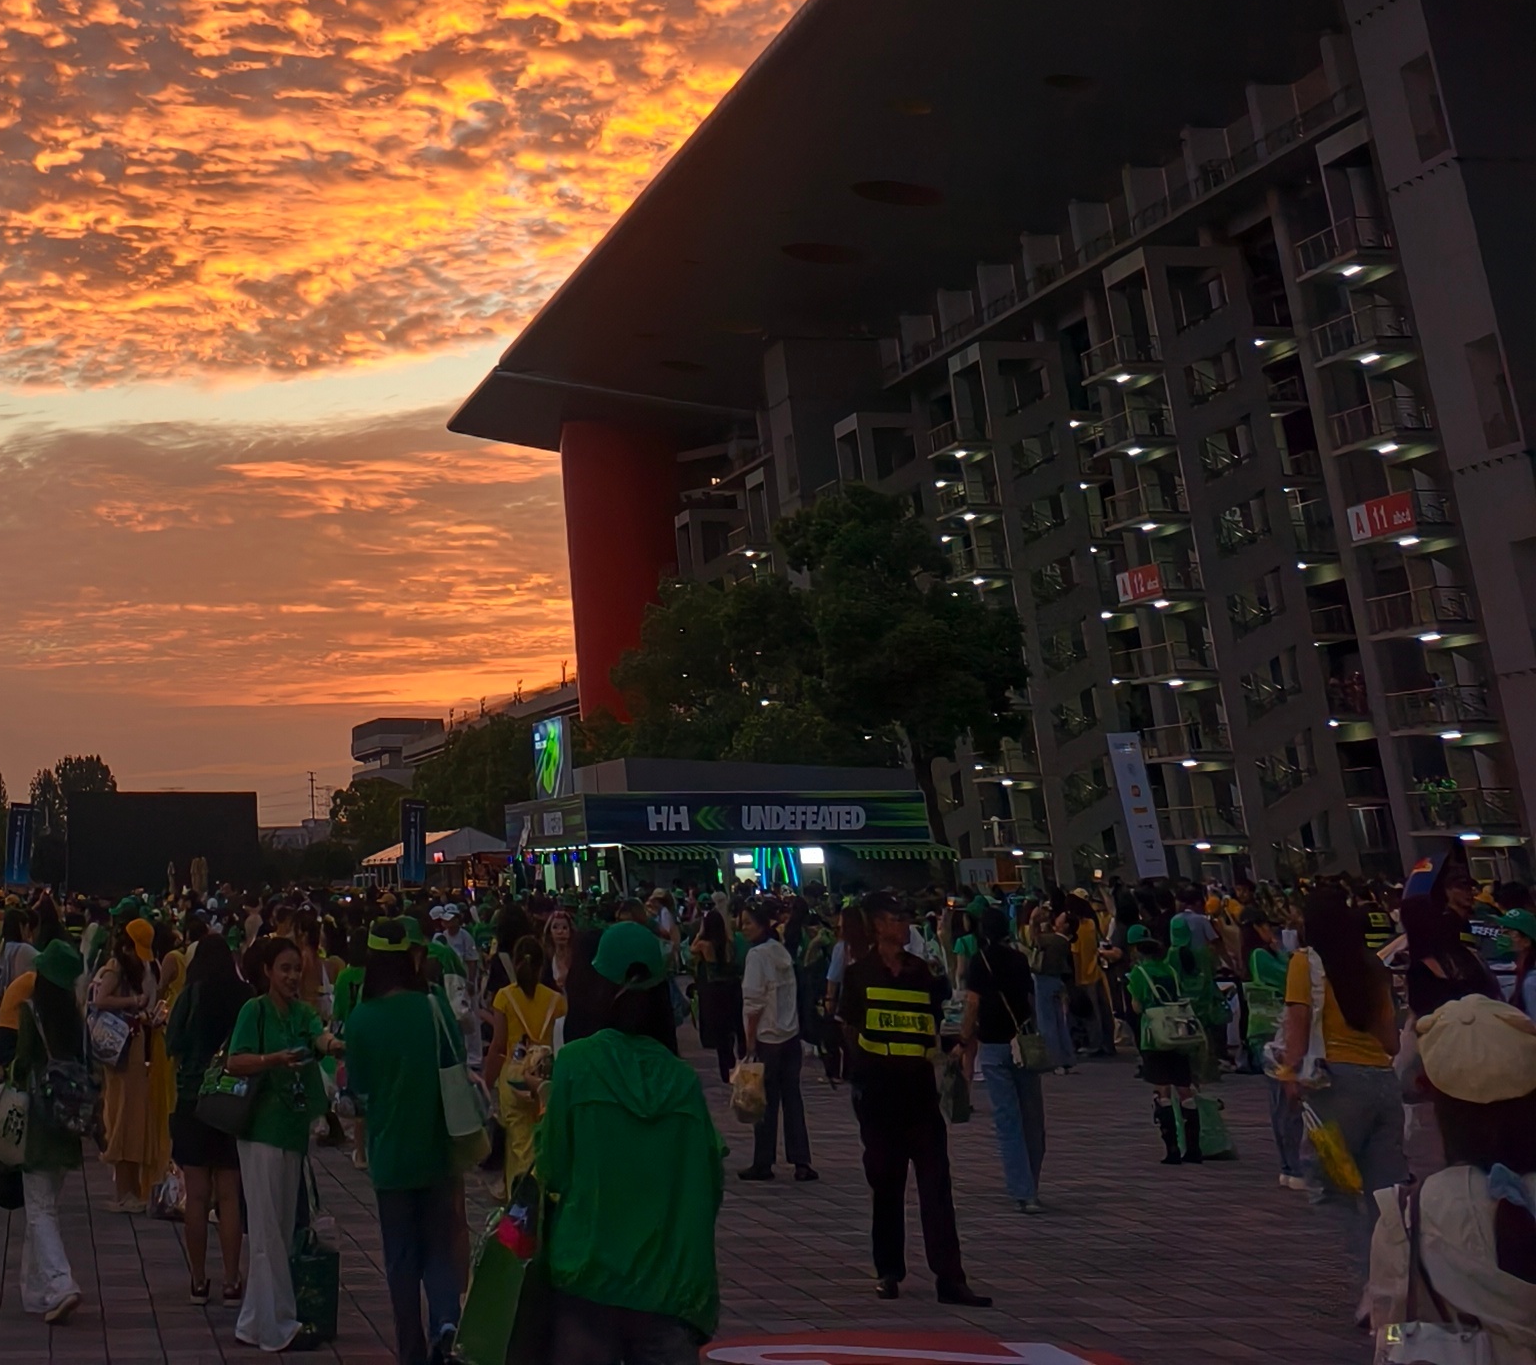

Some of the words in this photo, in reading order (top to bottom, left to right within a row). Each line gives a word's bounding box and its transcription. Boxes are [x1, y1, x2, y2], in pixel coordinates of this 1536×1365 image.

[1355, 511, 1366, 535] A
[1372, 504, 1388, 530] 11
[1120, 577, 1129, 596] A
[1133, 571, 1145, 594] 12
[741, 805, 866, 831] UNDEFEATED
